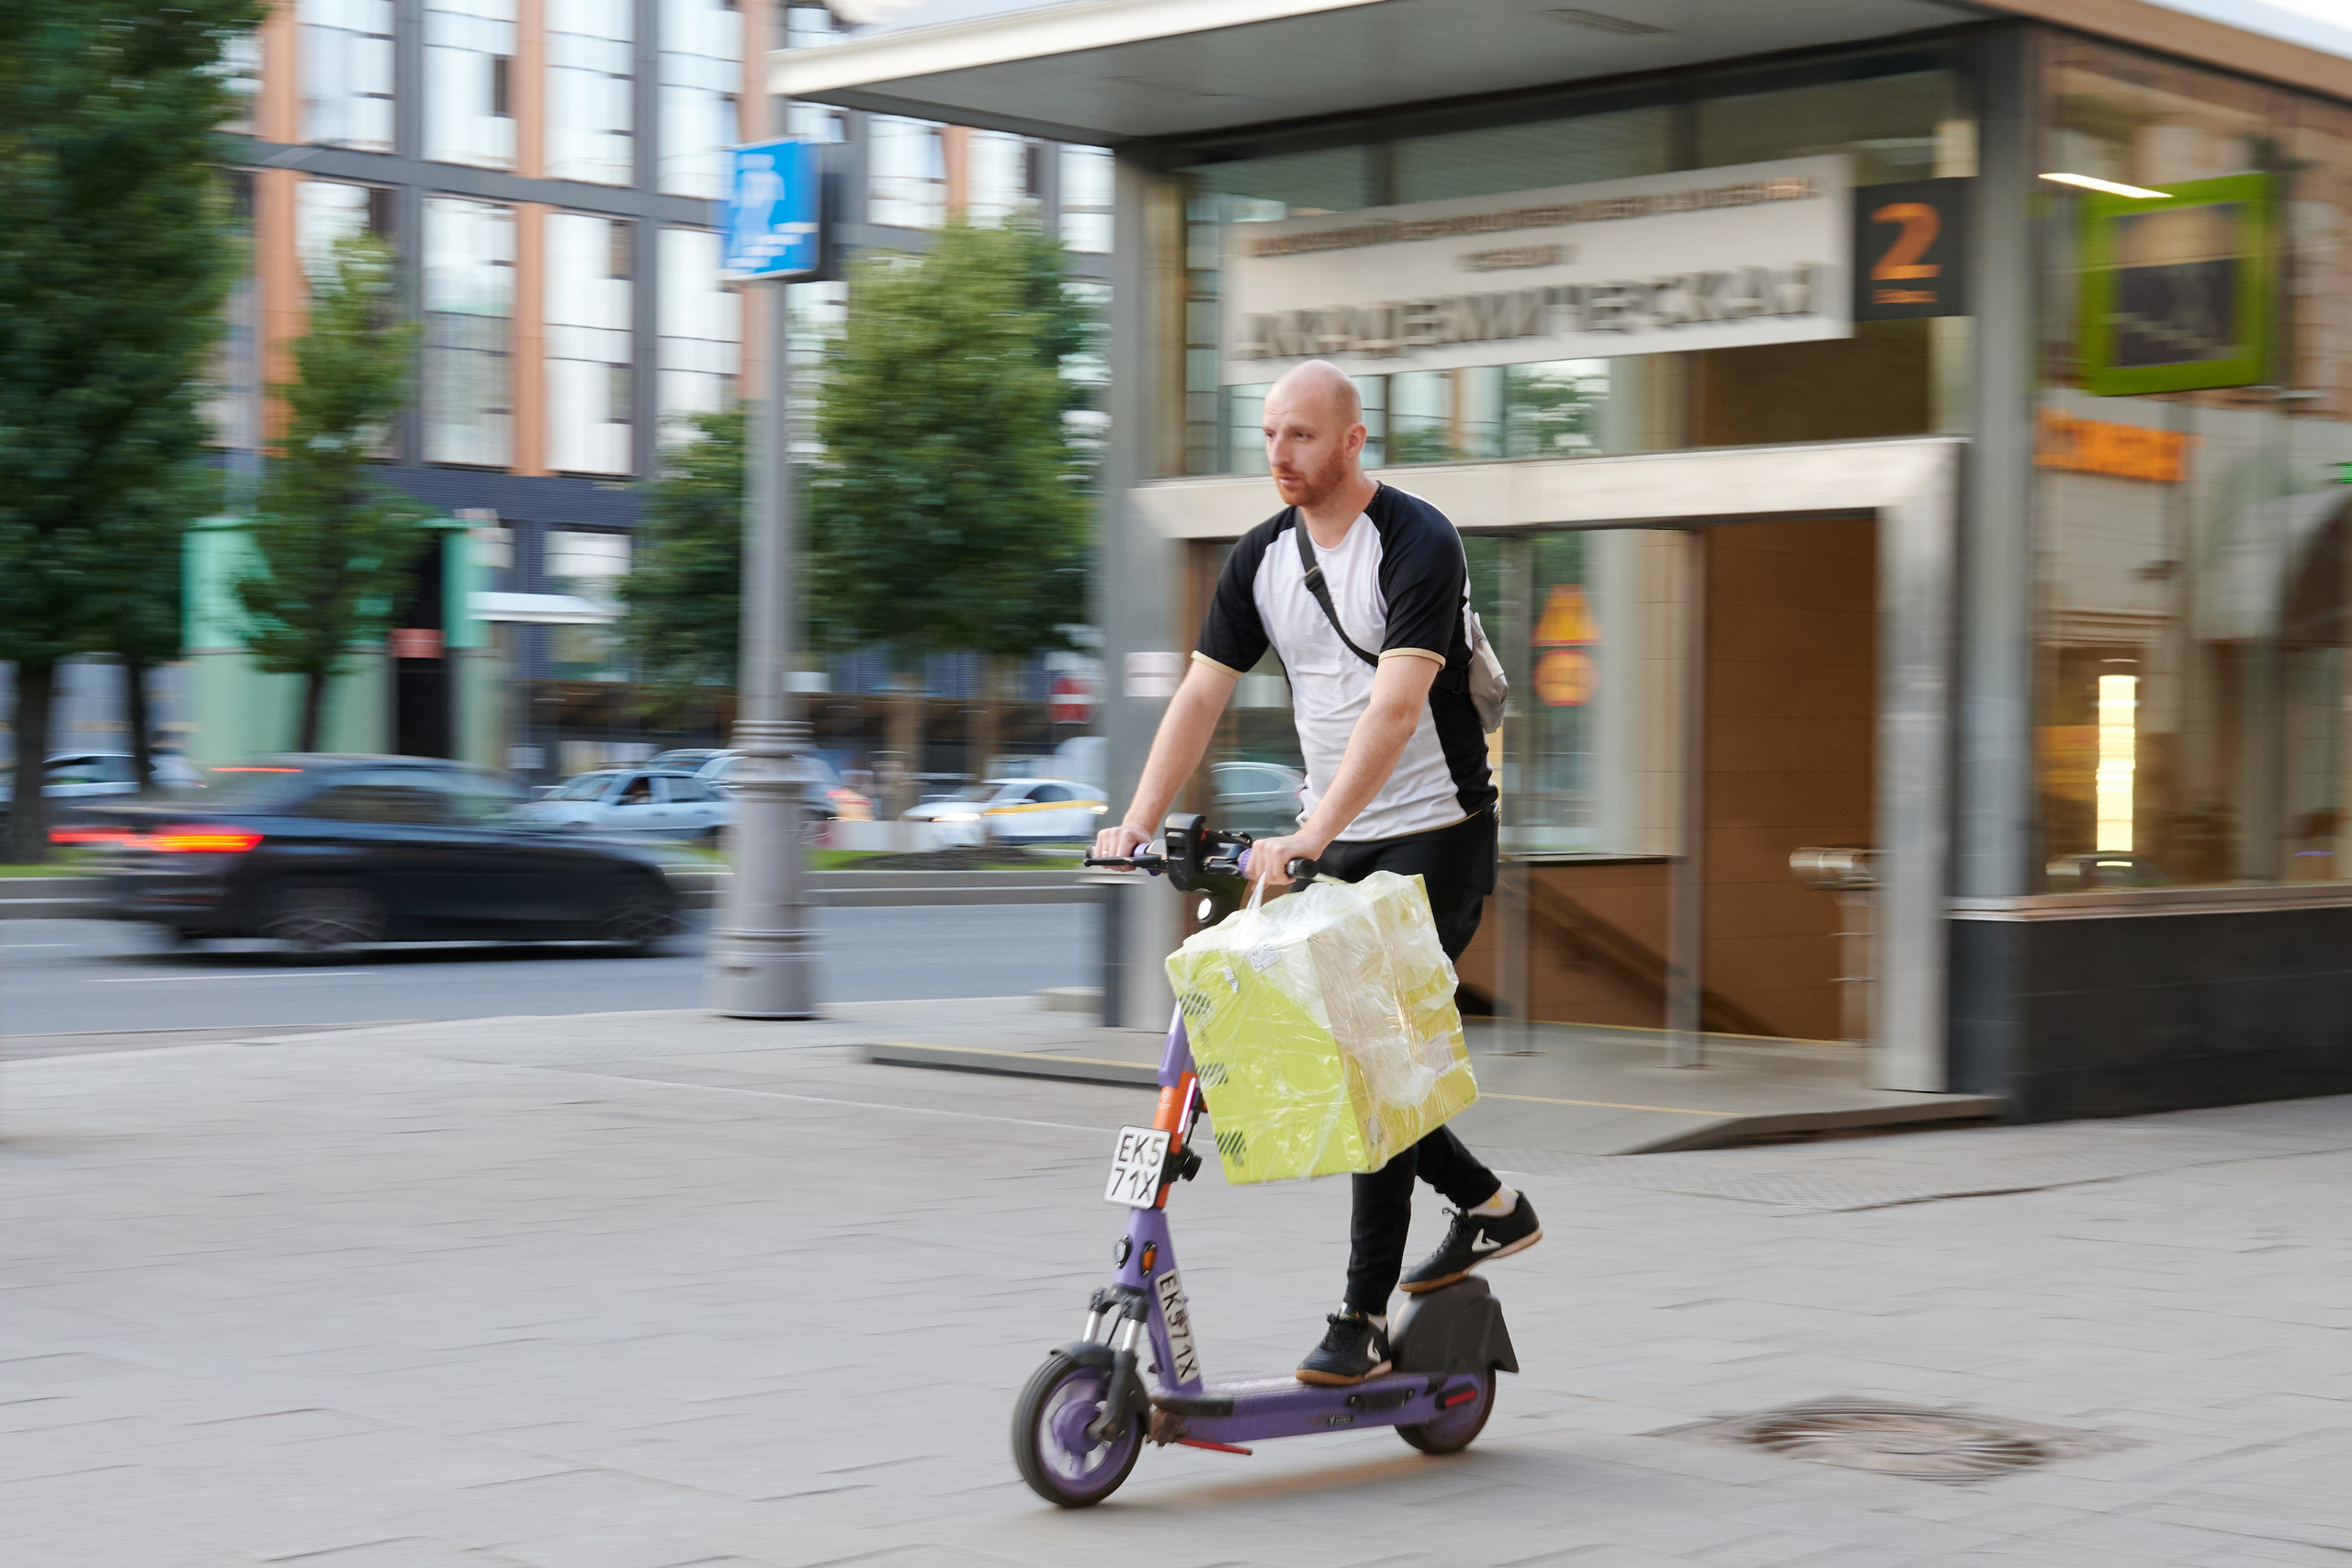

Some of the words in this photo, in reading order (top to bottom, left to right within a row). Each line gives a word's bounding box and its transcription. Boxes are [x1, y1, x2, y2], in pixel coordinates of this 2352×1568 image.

[1870, 202, 1943, 280] 2
[1118, 1134, 1165, 1167] EK5
[1112, 1168, 1158, 1201] 71X
